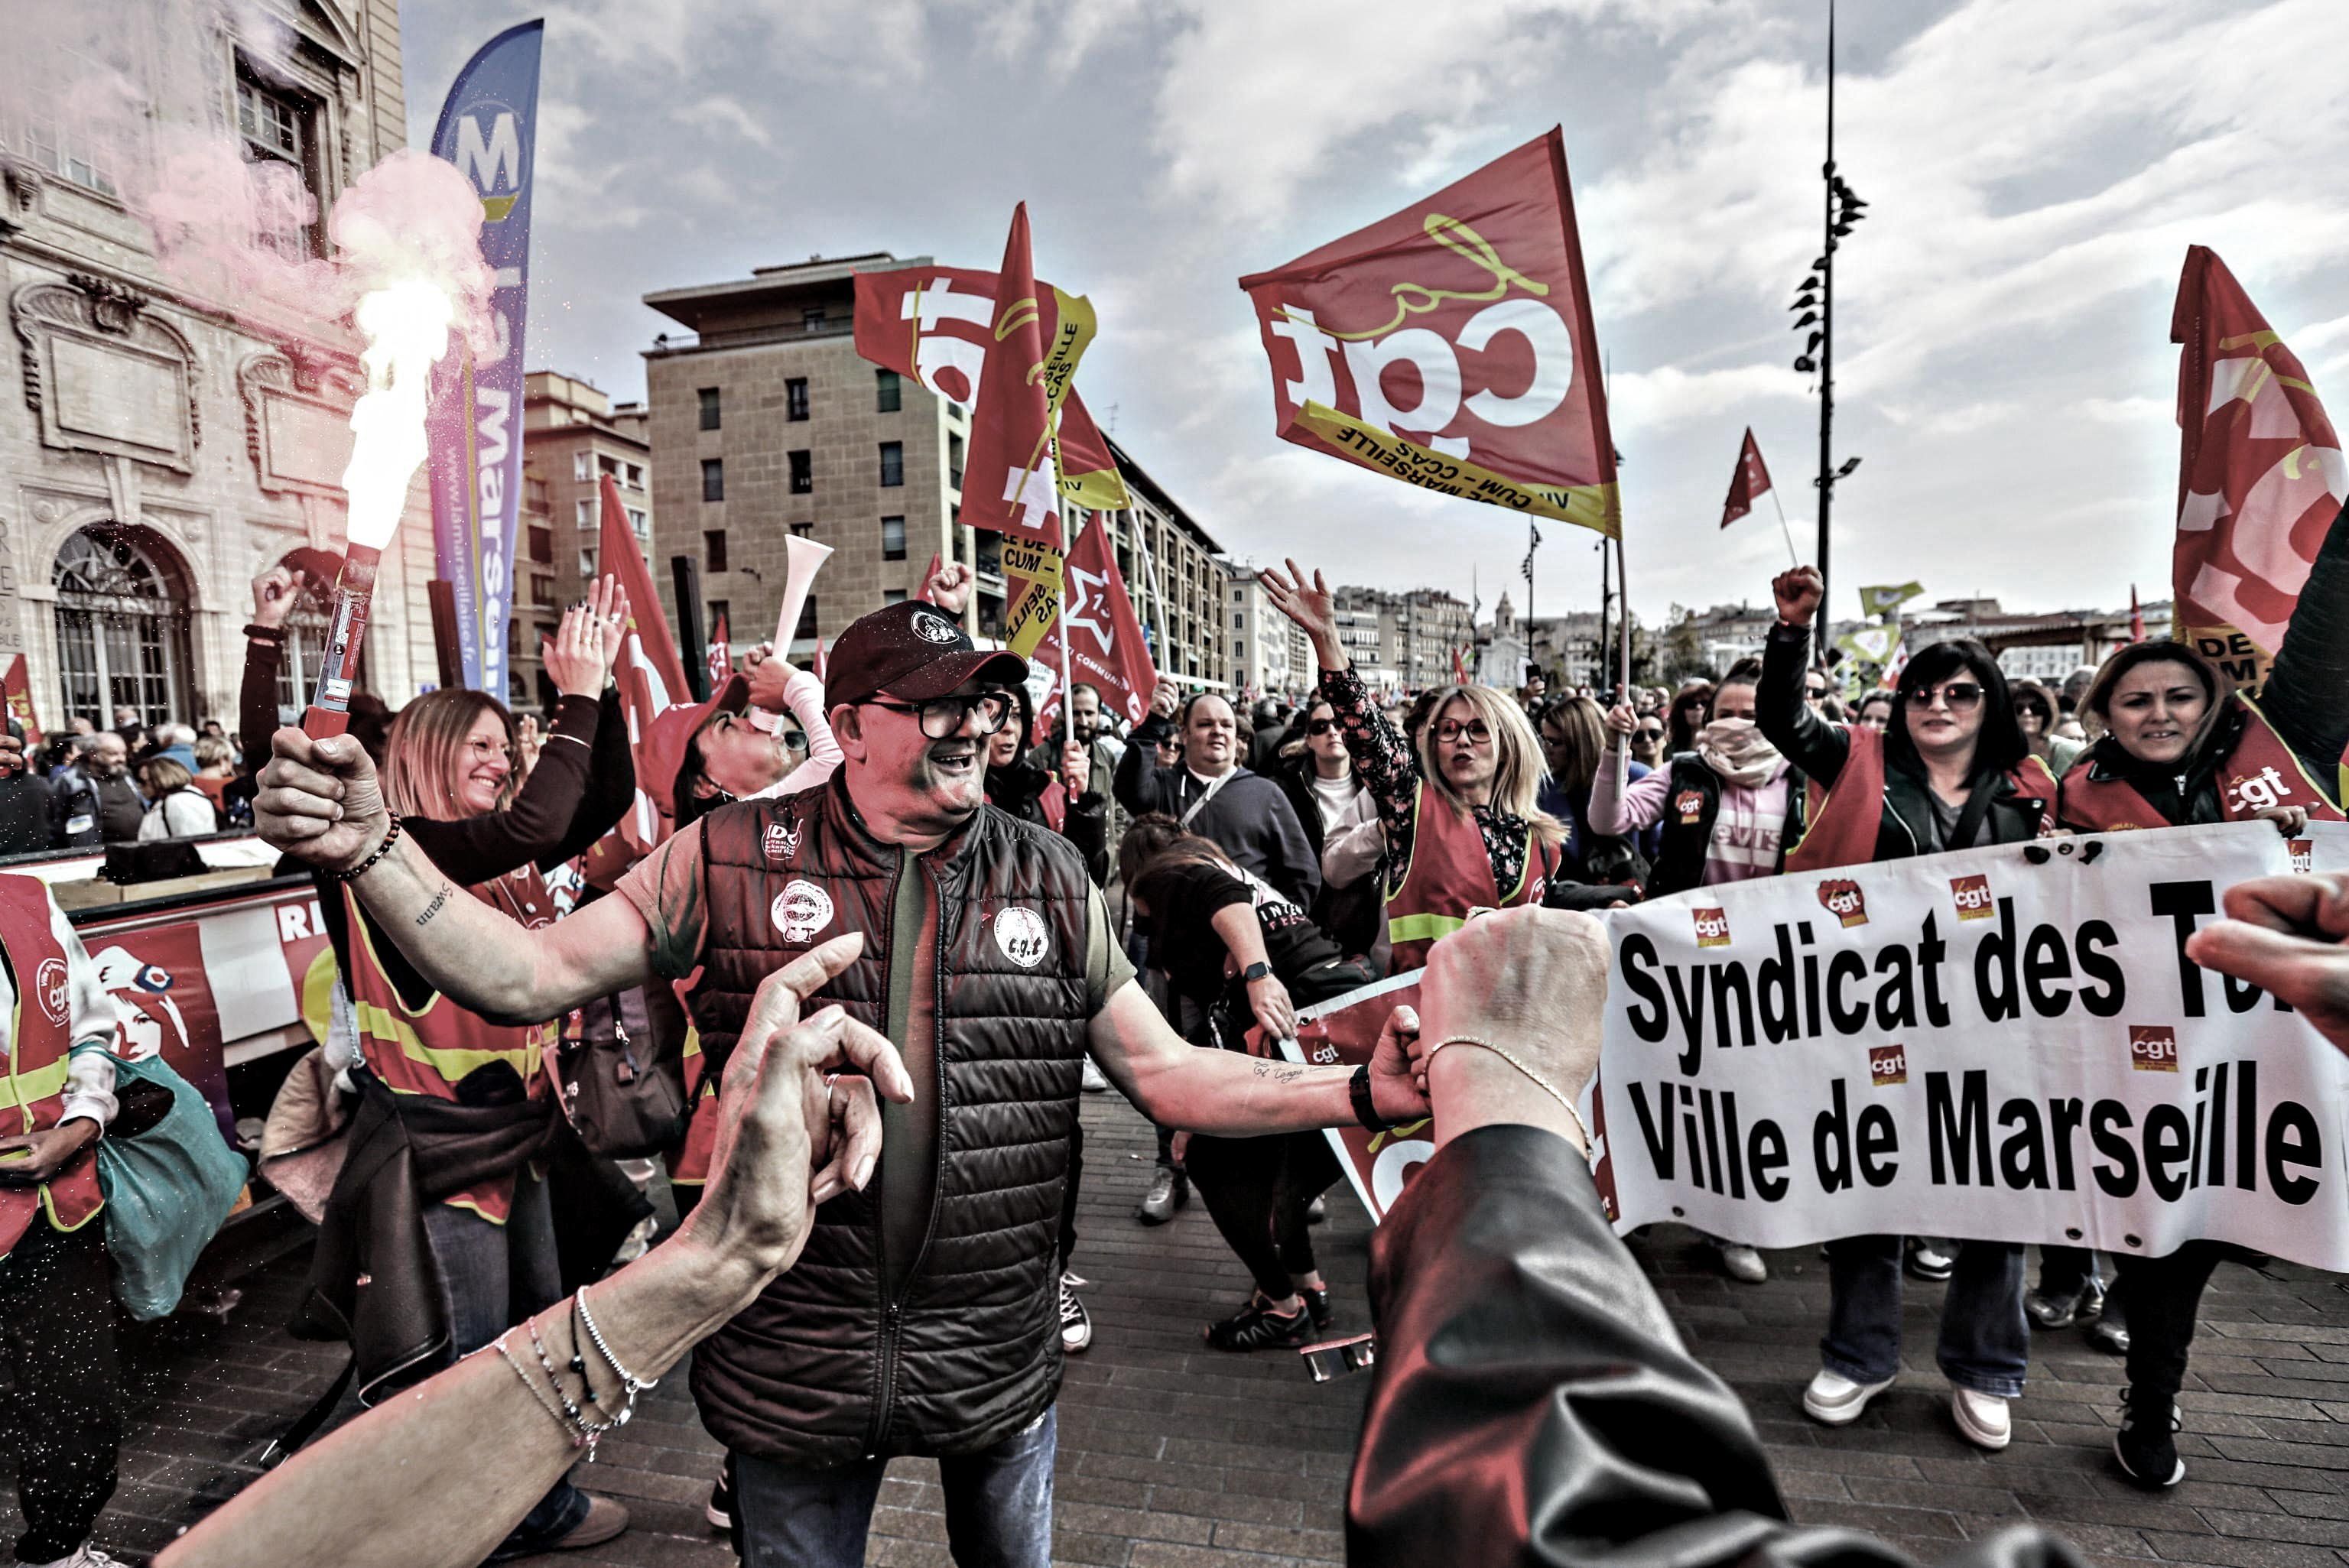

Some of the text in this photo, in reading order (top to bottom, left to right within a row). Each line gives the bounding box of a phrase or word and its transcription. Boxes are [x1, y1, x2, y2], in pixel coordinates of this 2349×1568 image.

[1395, 443, 1459, 480] CCAS
[1478, 478, 1532, 508] CUM
[1004, 548, 1041, 573] CUM
[2198, 633, 2255, 657] DE
[416, 881, 453, 925] Swann
[1828, 891, 1861, 913] cgt
[1955, 885, 1992, 908] cgt
[1695, 917, 1729, 937] cgt
[1620, 908, 1951, 1077] Syndicat
[1974, 896, 2126, 1022] des
[1313, 1044, 1339, 1063] cgt
[2133, 1038, 2175, 1060] cgt
[1872, 1054, 1906, 1075] cgt
[1626, 1060, 2322, 1206] Ville de Marseille
